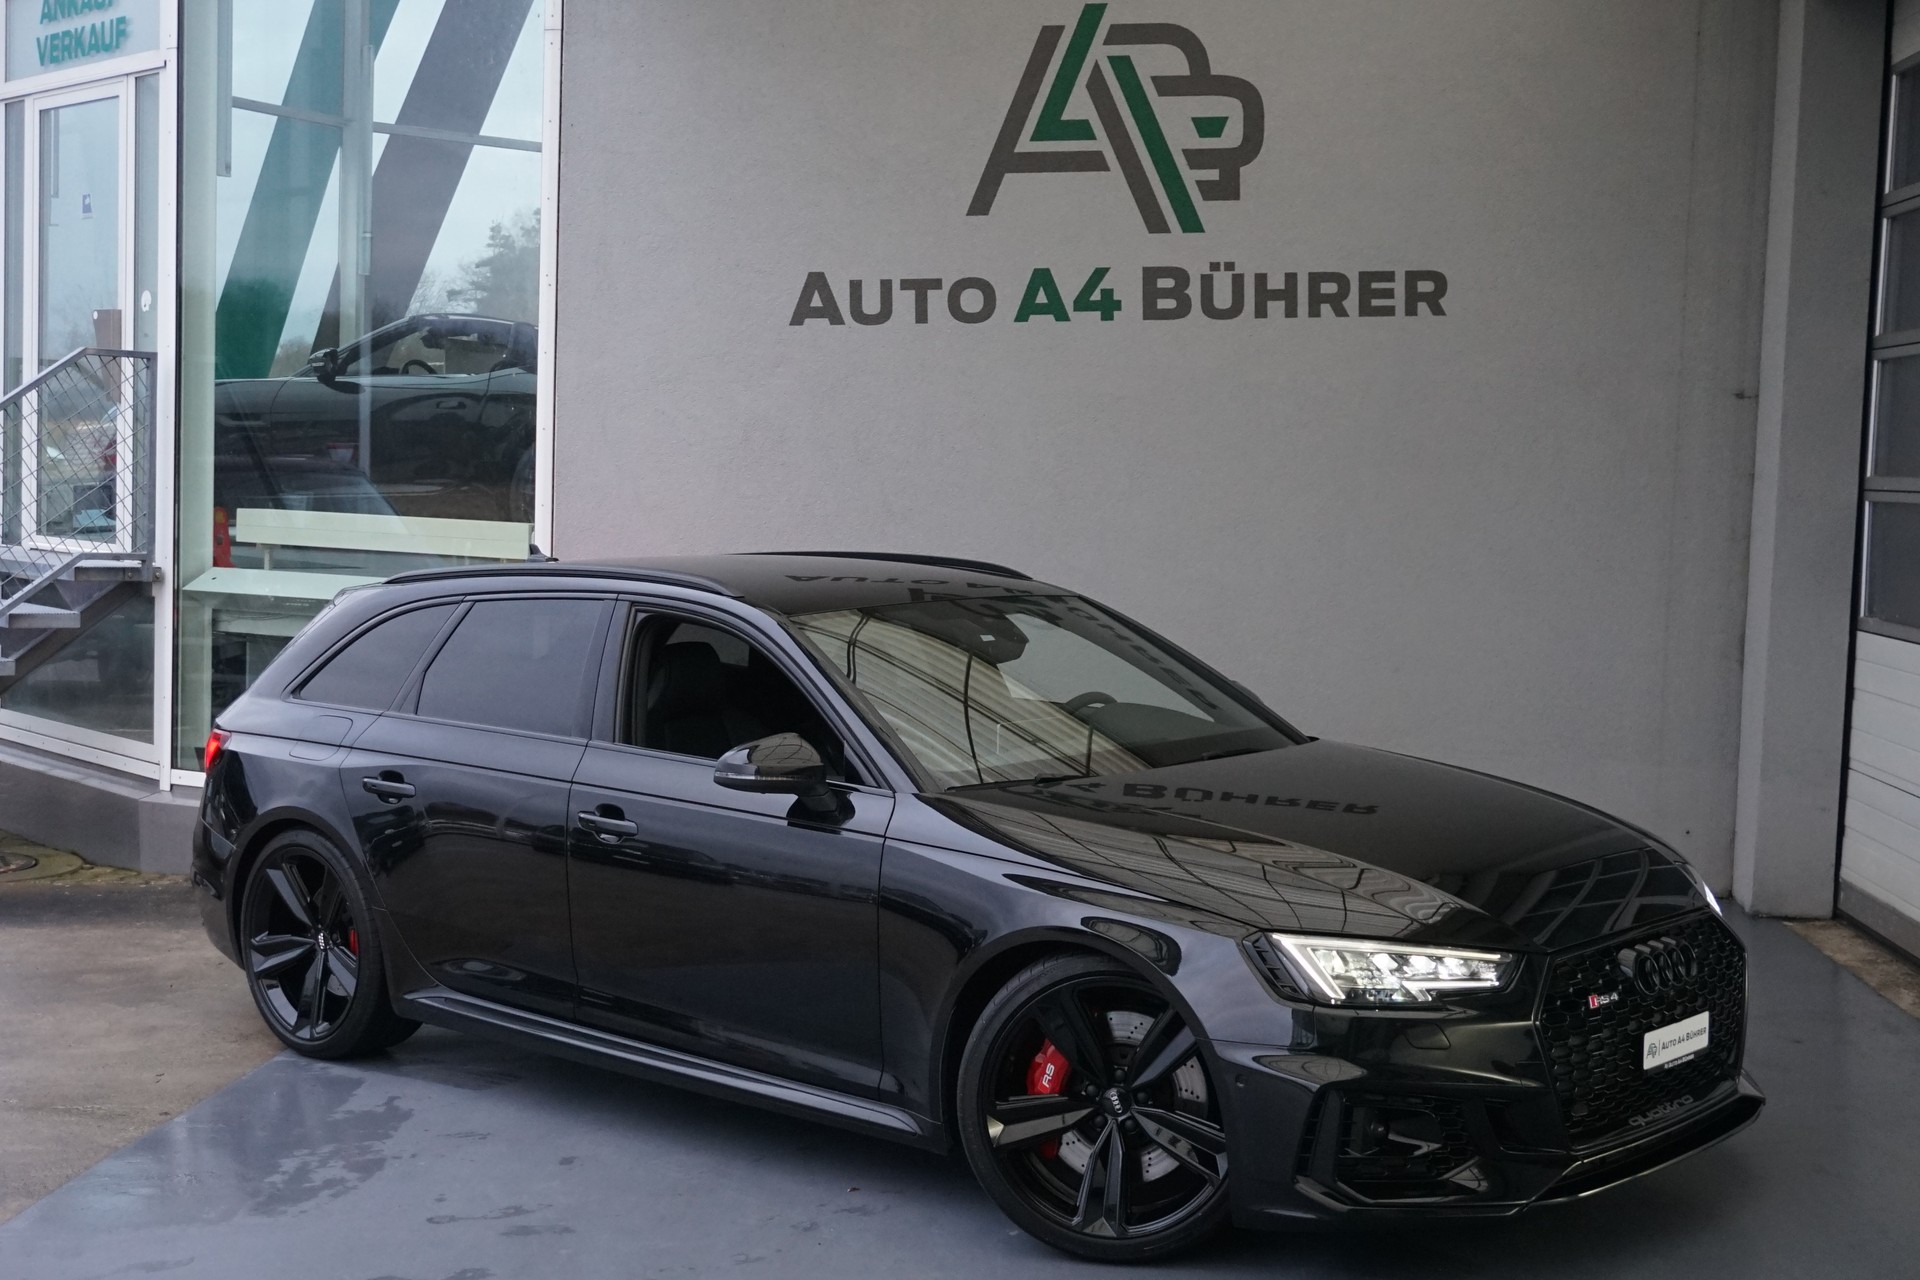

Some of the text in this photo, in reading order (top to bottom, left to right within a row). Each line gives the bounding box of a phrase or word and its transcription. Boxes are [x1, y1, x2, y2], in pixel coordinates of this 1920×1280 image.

[40, 0, 114, 24] ANK
[36, 16, 127, 66] VERKAUF
[789, 261, 1448, 326] AUTO A4 BÜHRER
[1661, 1039, 1677, 1051] AUTO
[1677, 1034, 1685, 1045] A4
[1686, 1026, 1707, 1042] BÜHRER
[1042, 1062, 1055, 1088] RS
[1628, 1094, 1694, 1126] quattro
